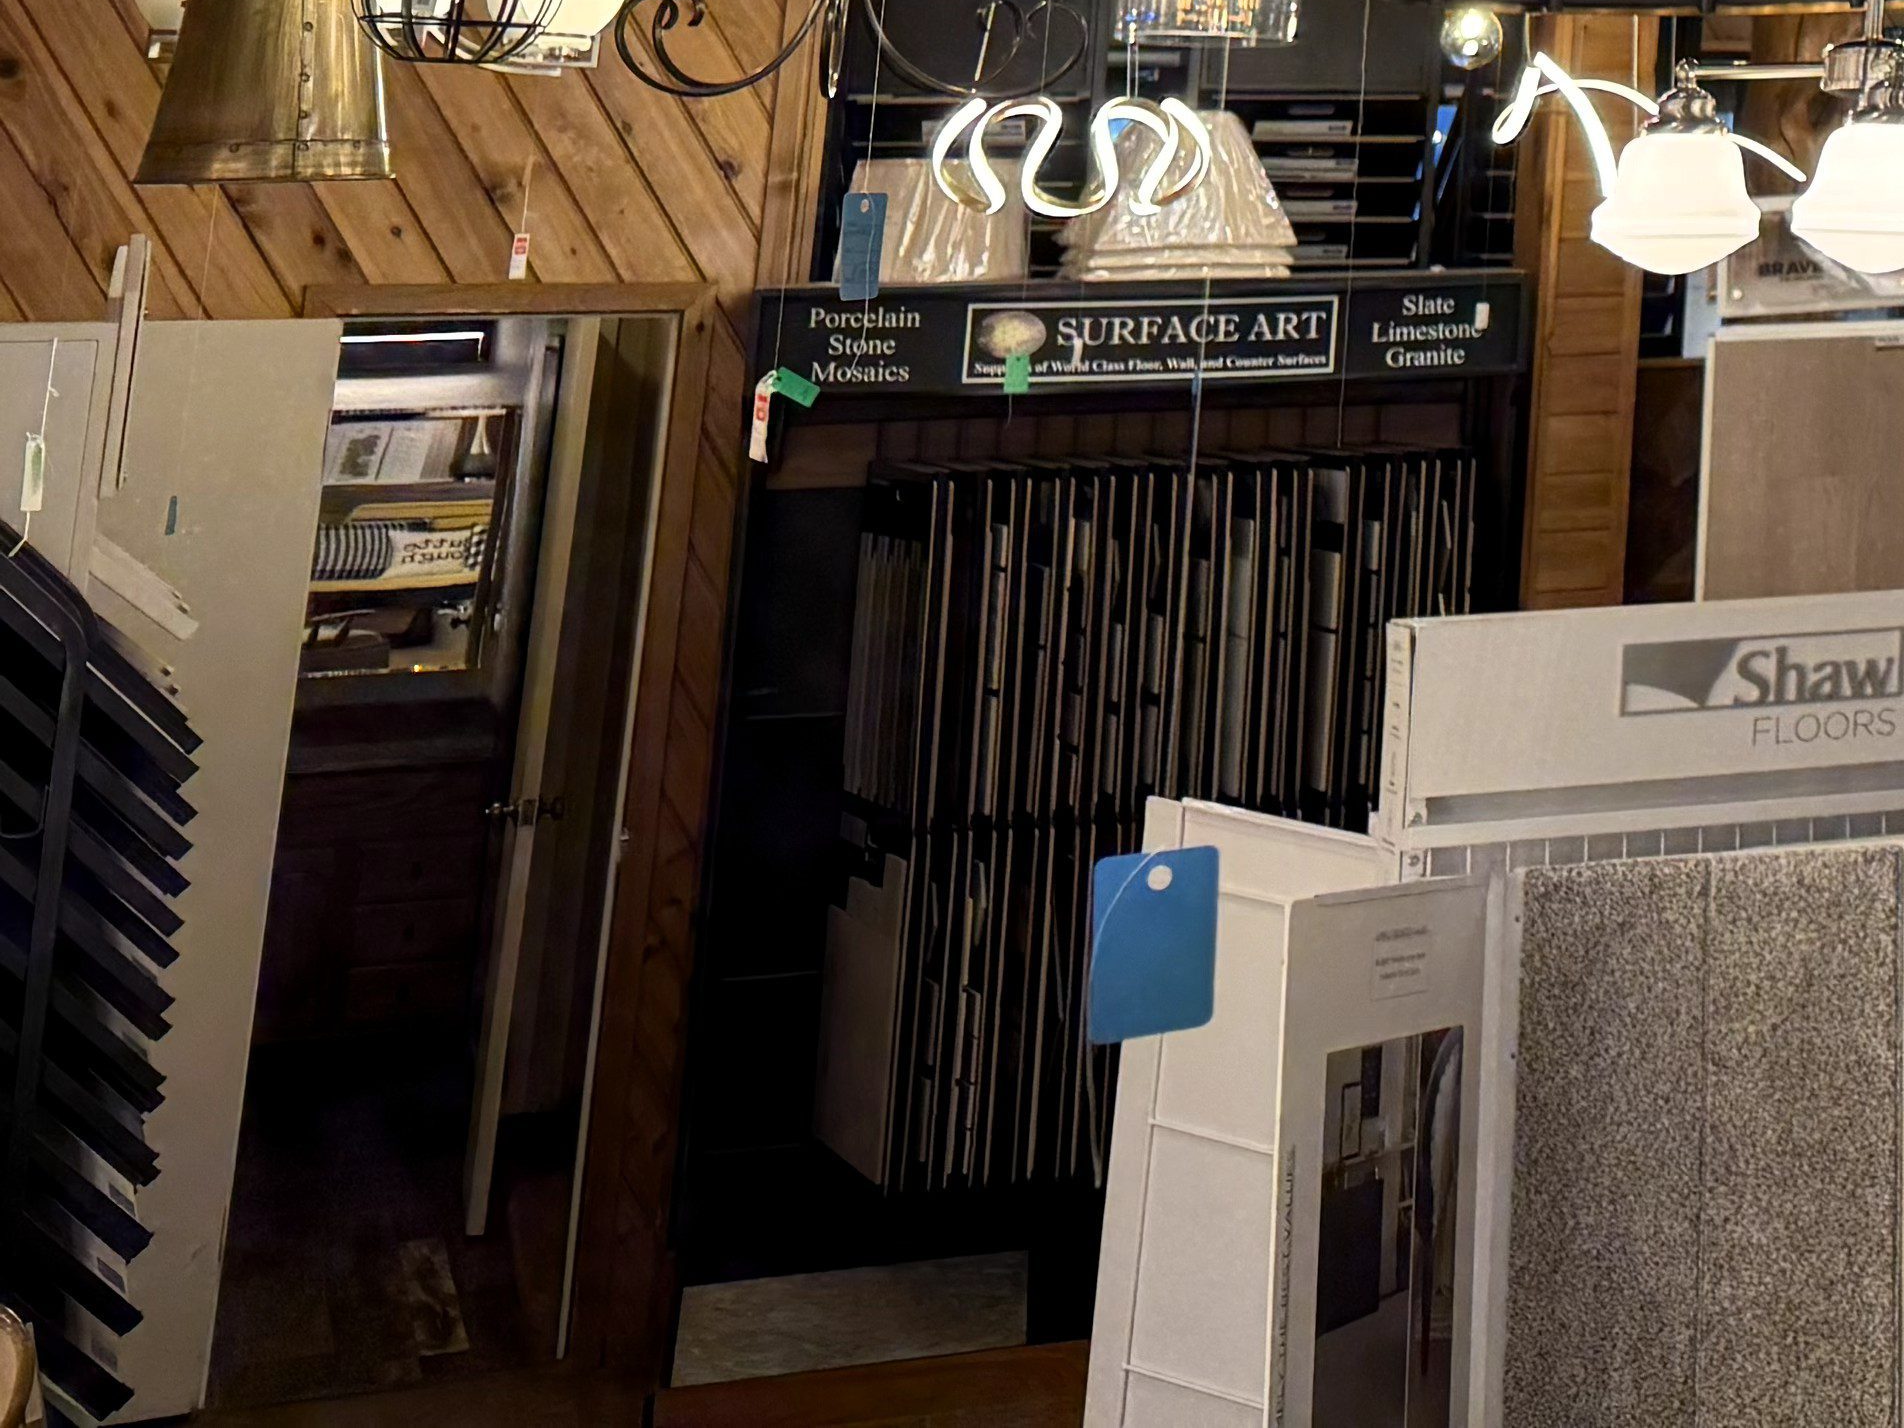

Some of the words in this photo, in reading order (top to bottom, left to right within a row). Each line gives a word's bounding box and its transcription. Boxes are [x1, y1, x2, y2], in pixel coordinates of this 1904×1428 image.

[1402, 294, 1455, 316] Slate
[808, 306, 920, 329] Porcelain
[1057, 311, 1239, 346] SURFACE
[1248, 311, 1326, 342] ART
[1371, 320, 1483, 343] Limestone
[828, 333, 896, 356] Stone
[1385, 344, 1466, 368] Granite
[811, 360, 910, 383] Mosaics
[1092, 358, 1124, 372] Class
[1278, 354, 1326, 366] Surfaces
[1733, 645, 1895, 708] Shaw
[1752, 708, 1897, 746] FLOORS
